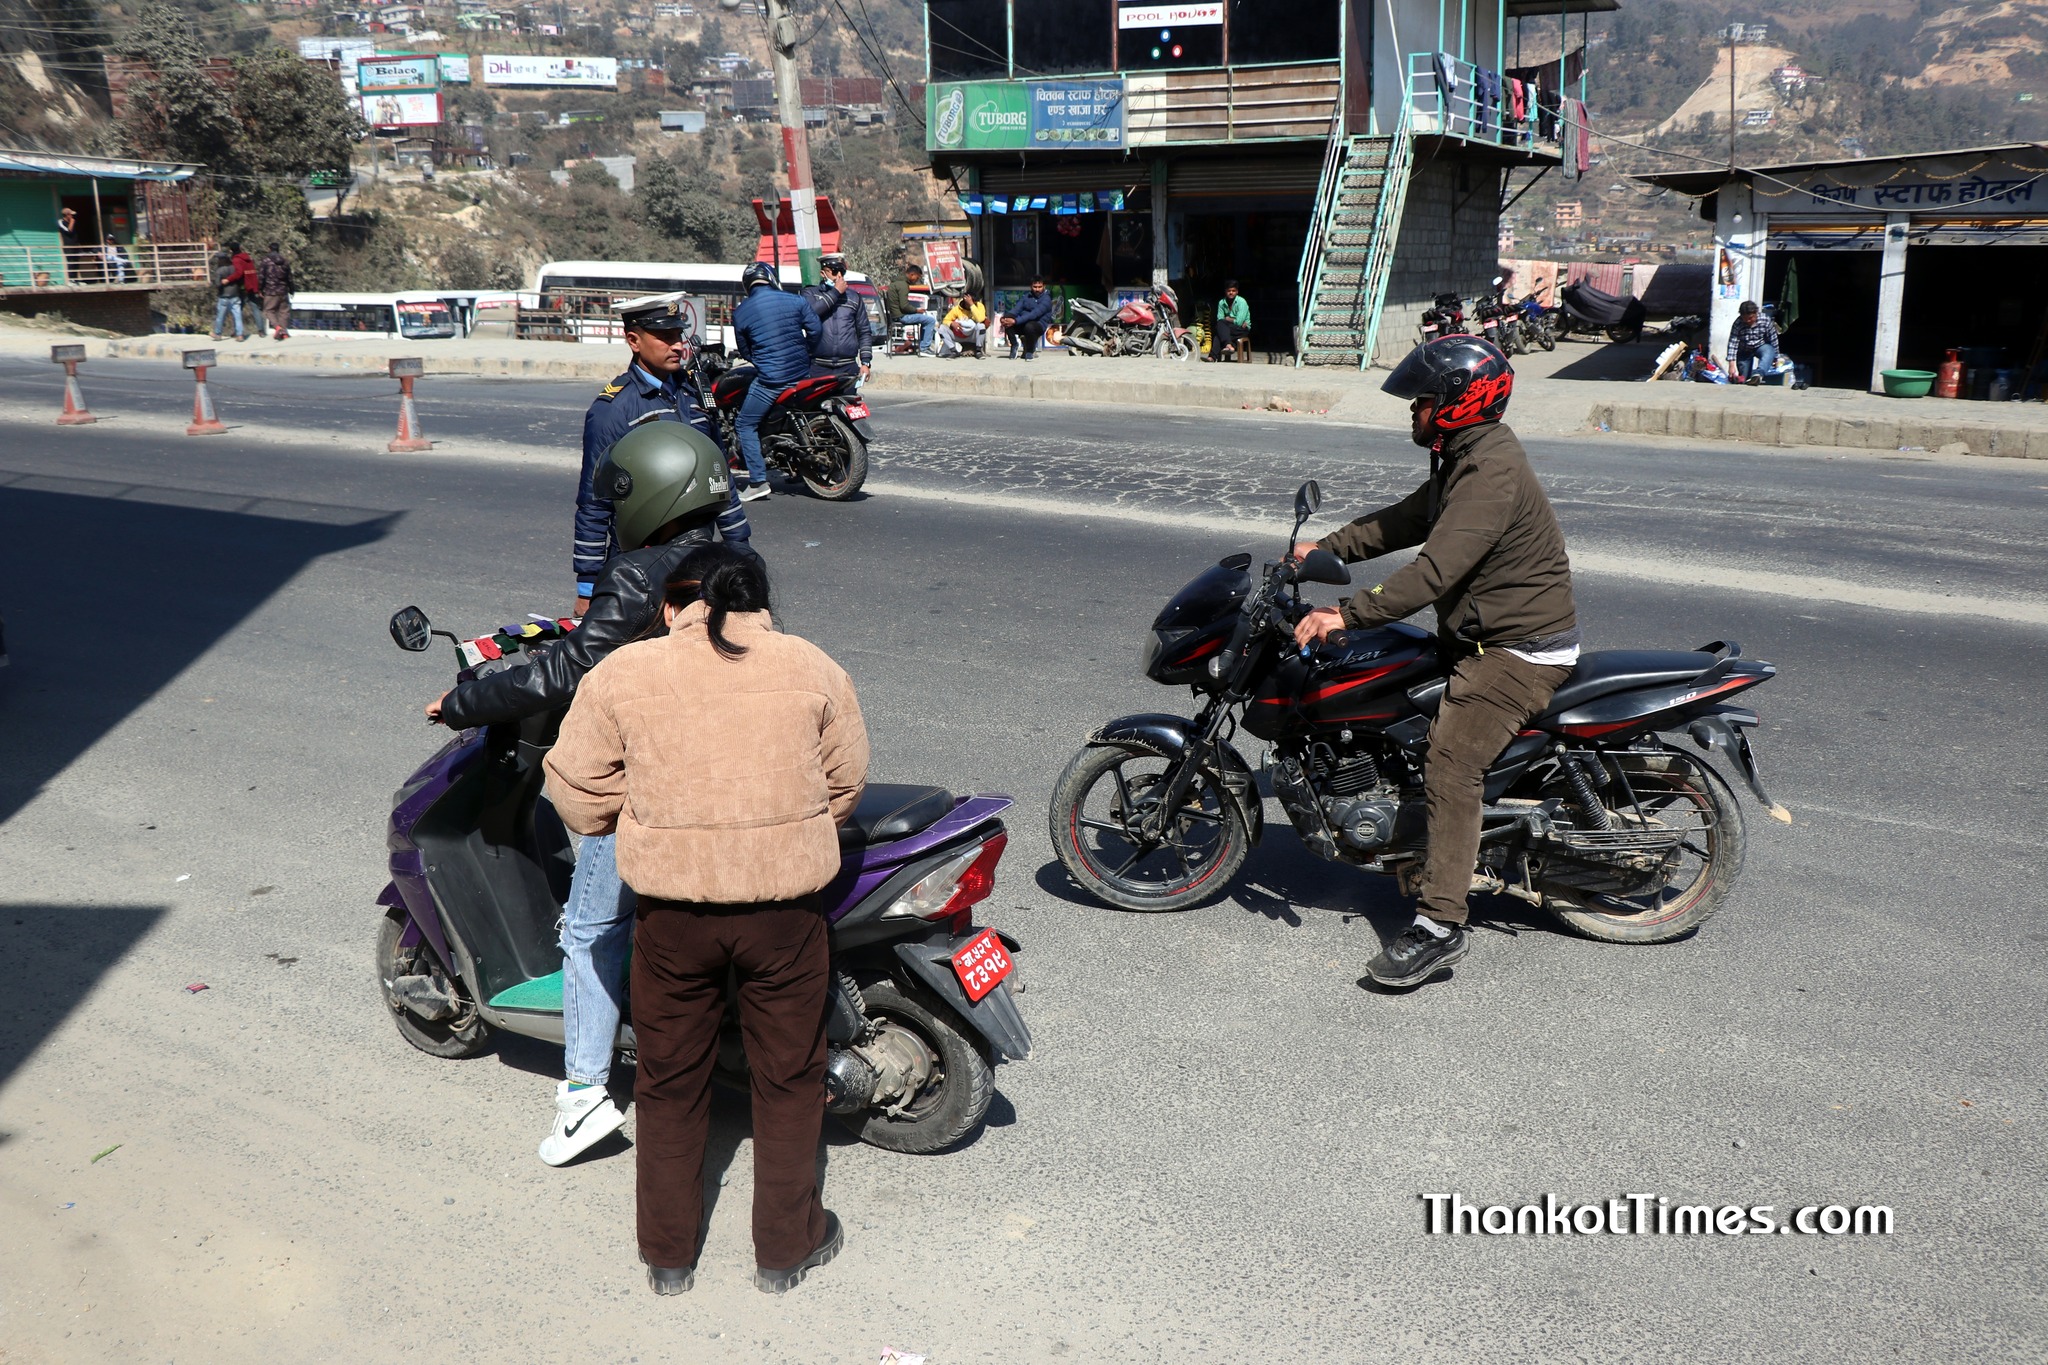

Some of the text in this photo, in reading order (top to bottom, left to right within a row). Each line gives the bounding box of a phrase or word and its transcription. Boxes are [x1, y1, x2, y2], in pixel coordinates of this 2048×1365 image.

[375, 66, 417, 76] Belaco
[1067, 89, 1092, 101] स्टाफ
[938, 101, 960, 140] TUBORG
[978, 111, 1027, 126] TUBORG
[1874, 183, 1952, 206] स्टाफ
[1958, 175, 2038, 205] होटल
[1669, 691, 1697, 706] 150
